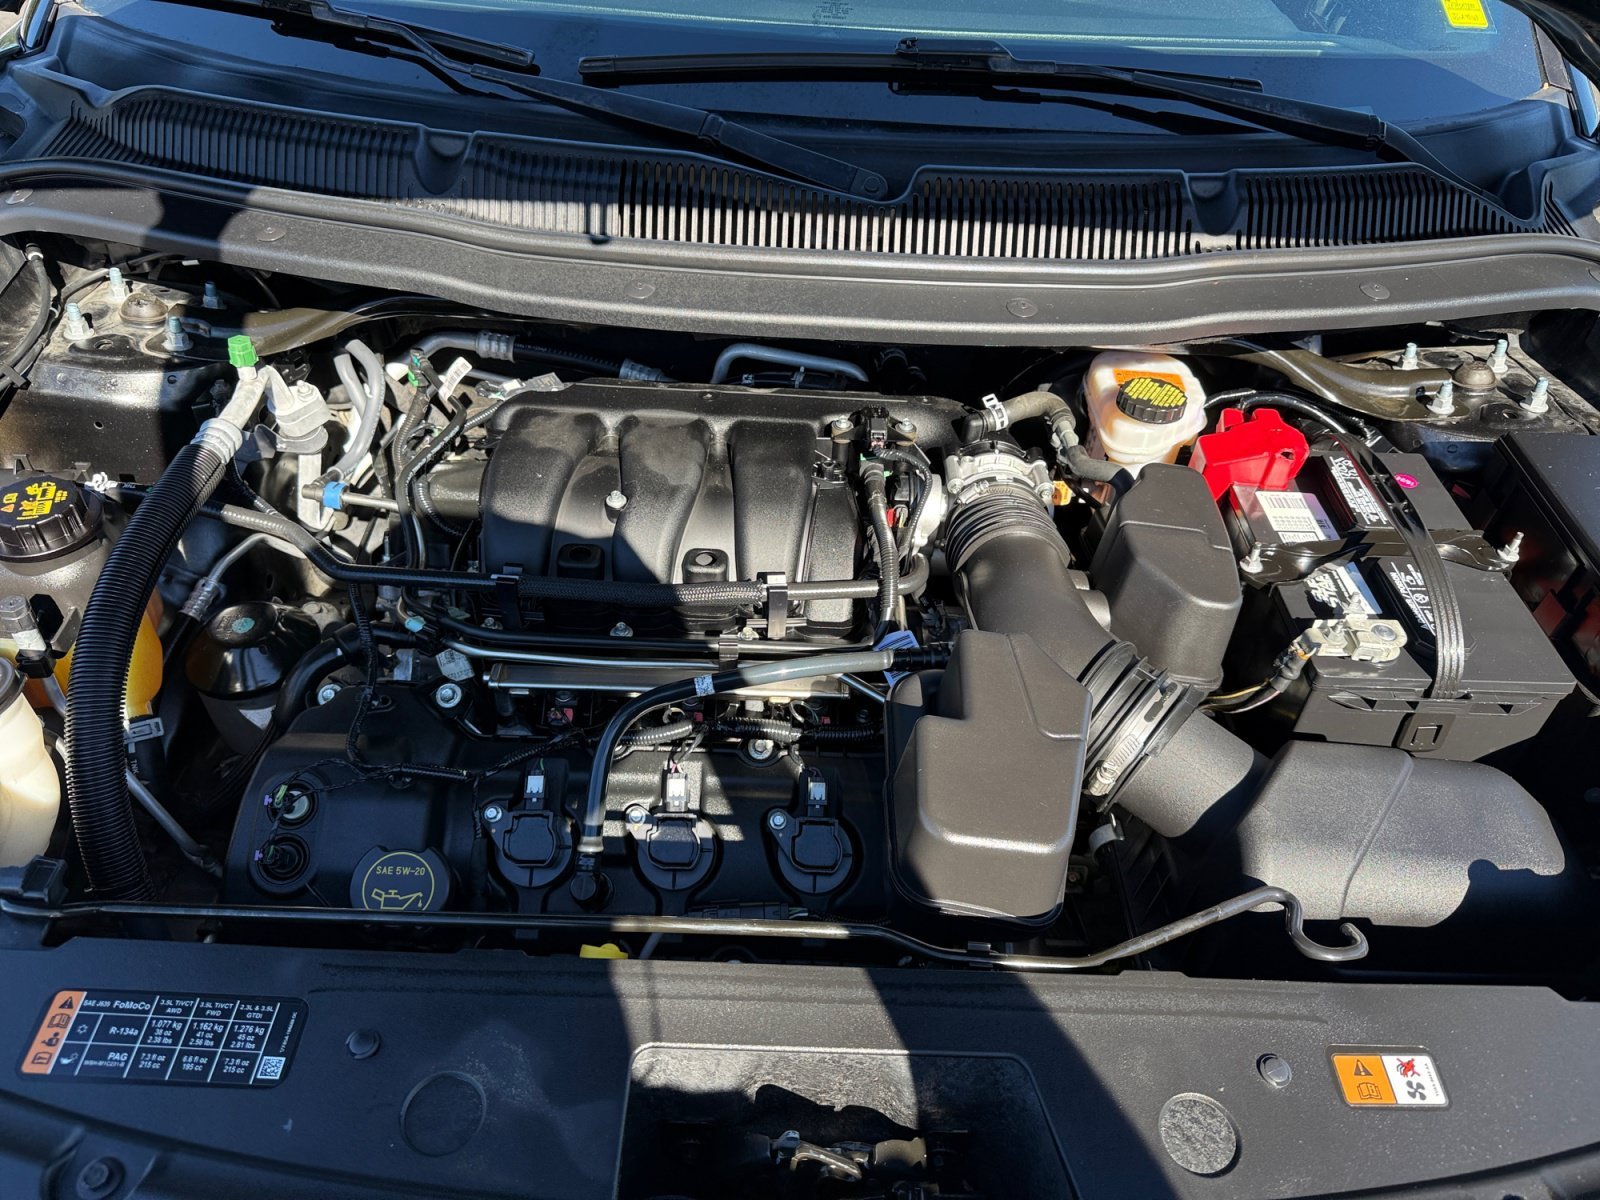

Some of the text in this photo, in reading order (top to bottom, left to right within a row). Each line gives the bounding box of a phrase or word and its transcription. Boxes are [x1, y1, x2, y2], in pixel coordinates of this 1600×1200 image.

[375, 866, 426, 876] SAE 5W-20
[113, 1000, 151, 1010] FoMoCo
[205, 1009, 222, 1017] FWD
[151, 1019, 183, 1031] 1.077 kg
[193, 1021, 224, 1033] 1.162 kg
[108, 1026, 139, 1036] R-134a
[233, 1024, 265, 1036] 1.276 kg
[162, 1036, 173, 1044] lbs
[237, 1033, 246, 1041] 45
[203, 1038, 214, 1047] lbs
[245, 1041, 256, 1049] lbs
[107, 1051, 128, 1061] PAG
[138, 1060, 152, 1069] 215
[182, 1063, 194, 1071] 195
[223, 1065, 237, 1074] 215
